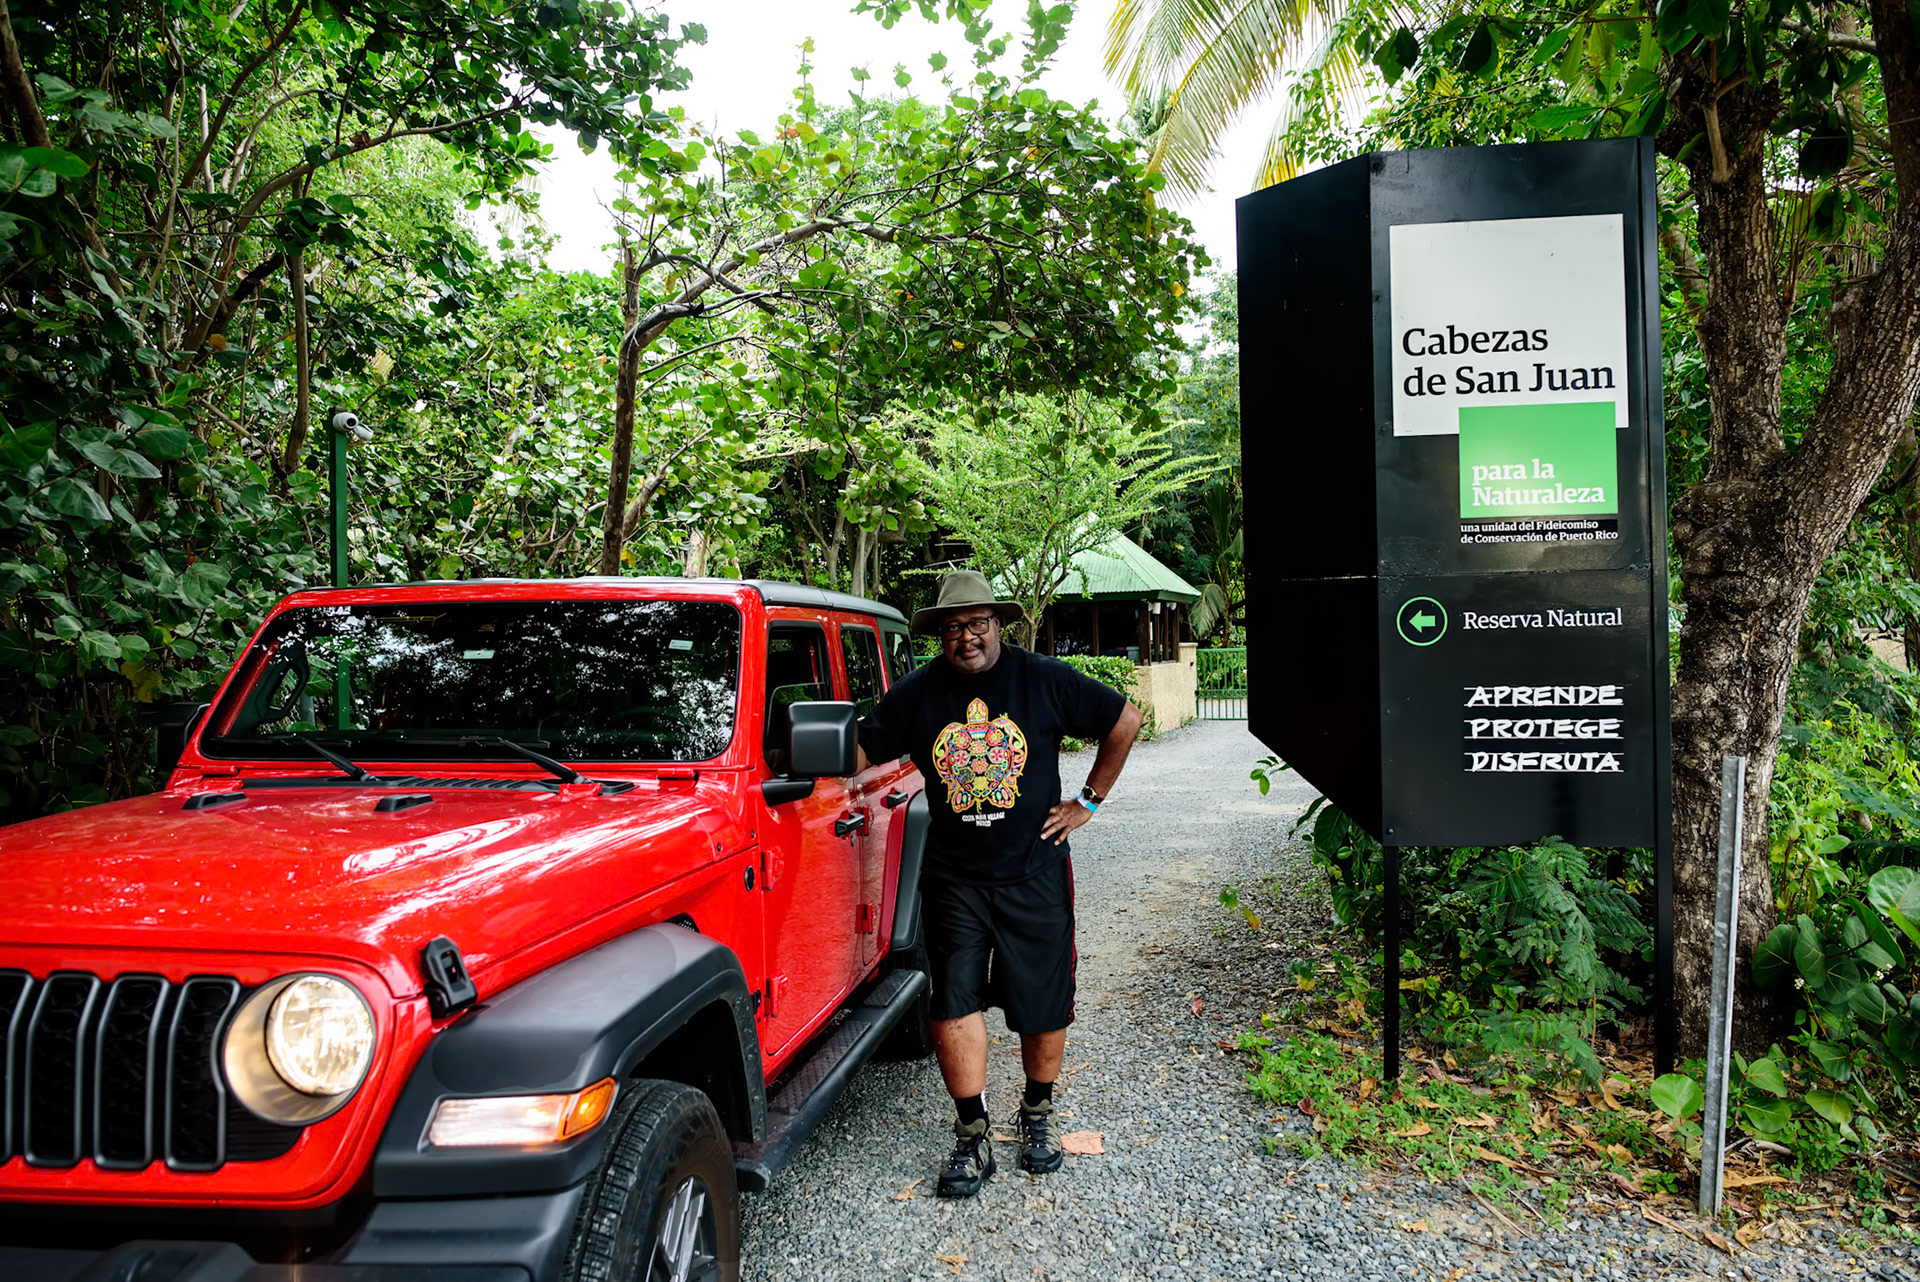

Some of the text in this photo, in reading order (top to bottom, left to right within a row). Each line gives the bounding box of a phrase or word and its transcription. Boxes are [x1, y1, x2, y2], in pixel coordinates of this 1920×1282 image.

[1402, 324, 1549, 356] Cabezas
[1403, 363, 1616, 397] de San Juan
[1472, 458, 1555, 486] para la
[1472, 483, 1606, 507] Naturaleza
[1460, 519, 1599, 533] una unidad del Fideicomiso
[1460, 530, 1619, 544] de Conservación de Puerto Rico
[1463, 608, 1624, 630] Reserva Natural
[1466, 685, 1624, 708] APRENDE
[1469, 718, 1621, 739] PROTEGE
[1471, 752, 1621, 773] DISFRUTA
